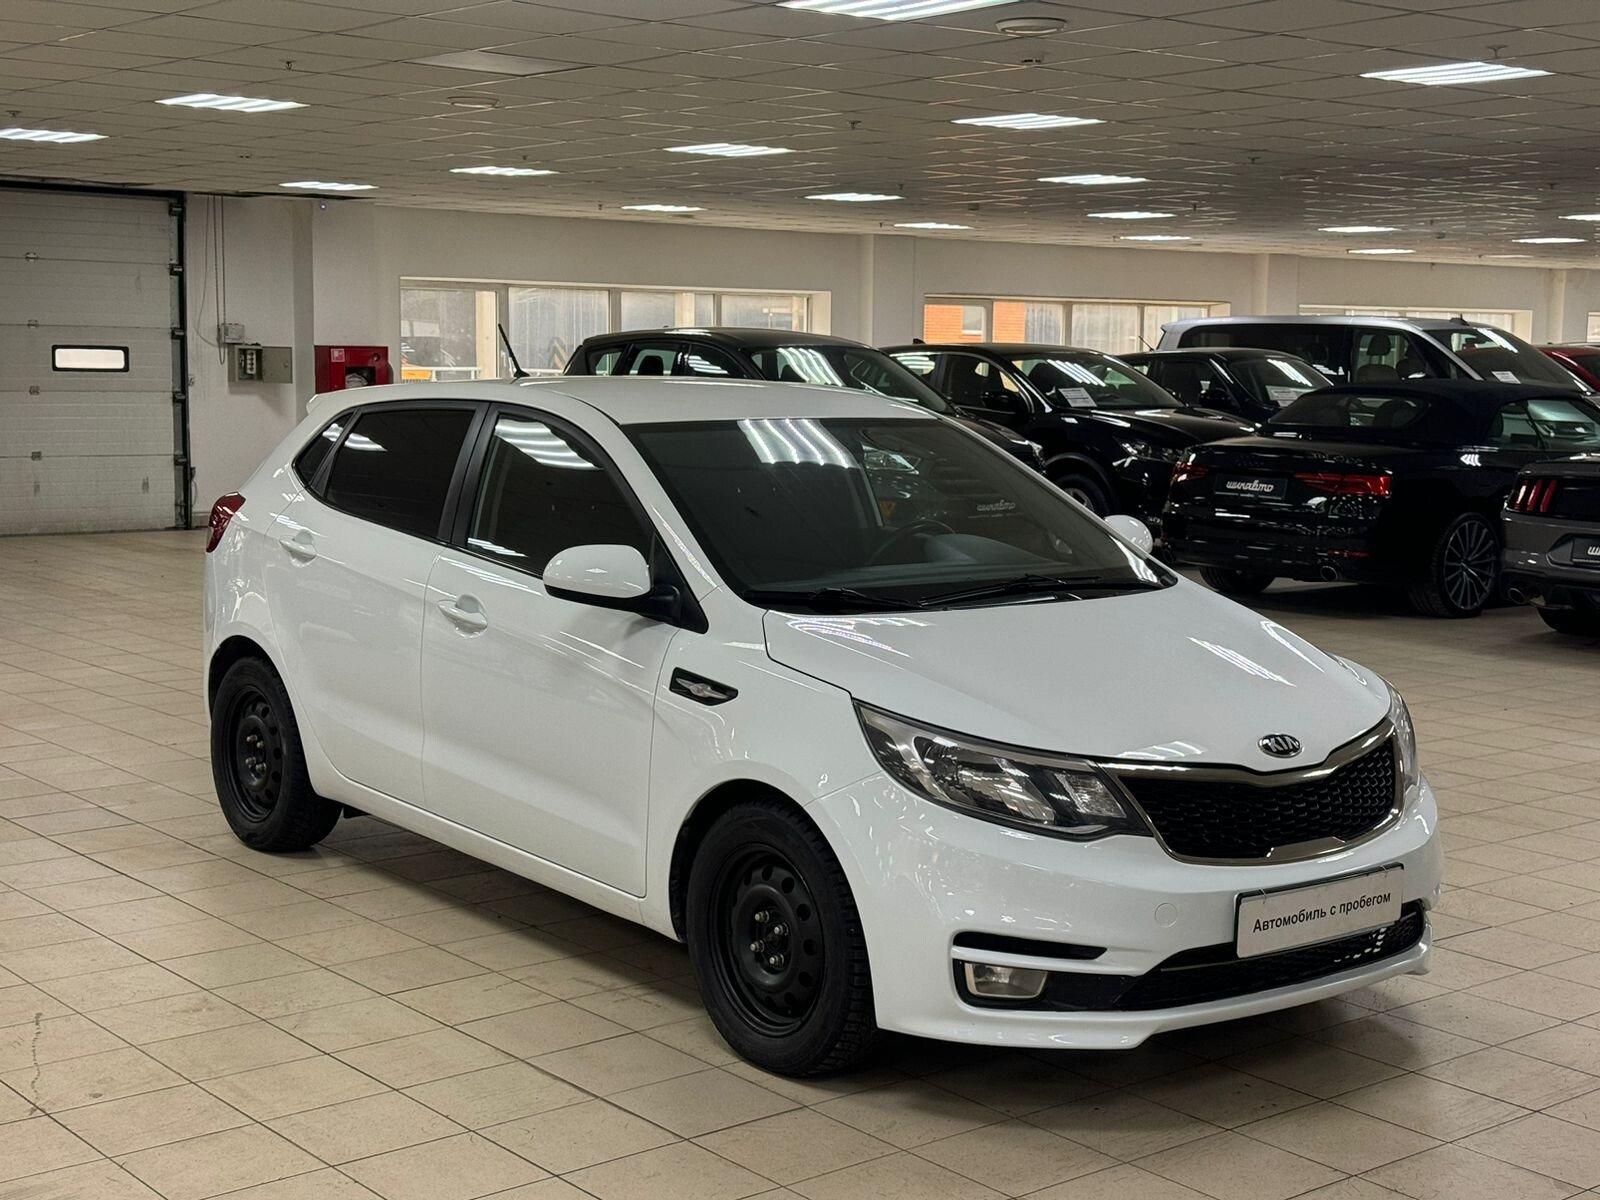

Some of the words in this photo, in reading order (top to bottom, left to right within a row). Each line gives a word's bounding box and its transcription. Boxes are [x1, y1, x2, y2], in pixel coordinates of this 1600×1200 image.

[1266, 736, 1300, 752] KIA
[1253, 909, 1326, 933] Автомобиль
[1329, 905, 1336, 916] с
[1339, 893, 1391, 916] пробегом
